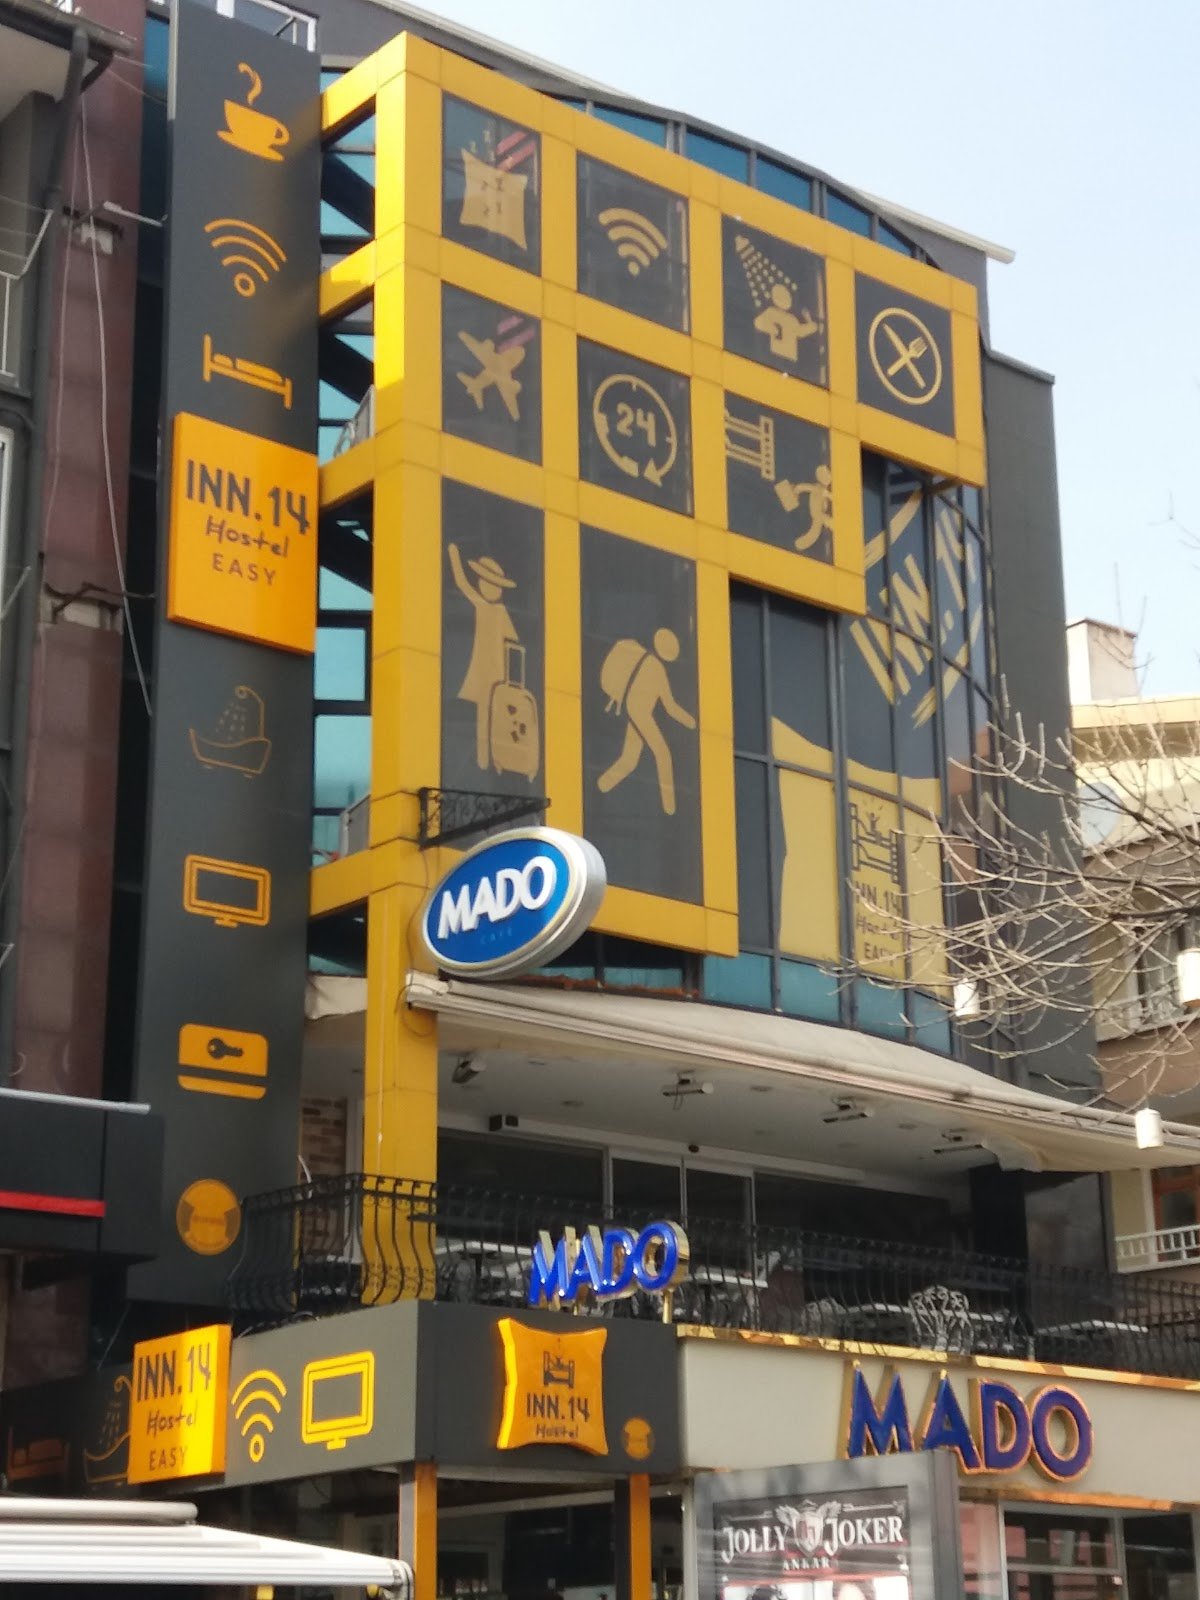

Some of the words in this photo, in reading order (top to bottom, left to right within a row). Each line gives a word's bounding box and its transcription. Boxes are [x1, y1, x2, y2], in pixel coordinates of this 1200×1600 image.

[616, 402, 656, 448] 24
[186, 458, 310, 535] INN.14
[204, 515, 290, 558] Hostel
[212, 552, 276, 586] EASY
[436, 855, 558, 940] MADO
[528, 1221, 685, 1308] MADO
[137, 1342, 212, 1403] INN.14
[146, 1400, 198, 1438] Hostel
[526, 1392, 591, 1433] INN.14
[842, 1358, 1094, 1482] MADO
[149, 1446, 188, 1471] EASY
[721, 1525, 791, 1564] JOLLY
[824, 1516, 904, 1556] JOKER
